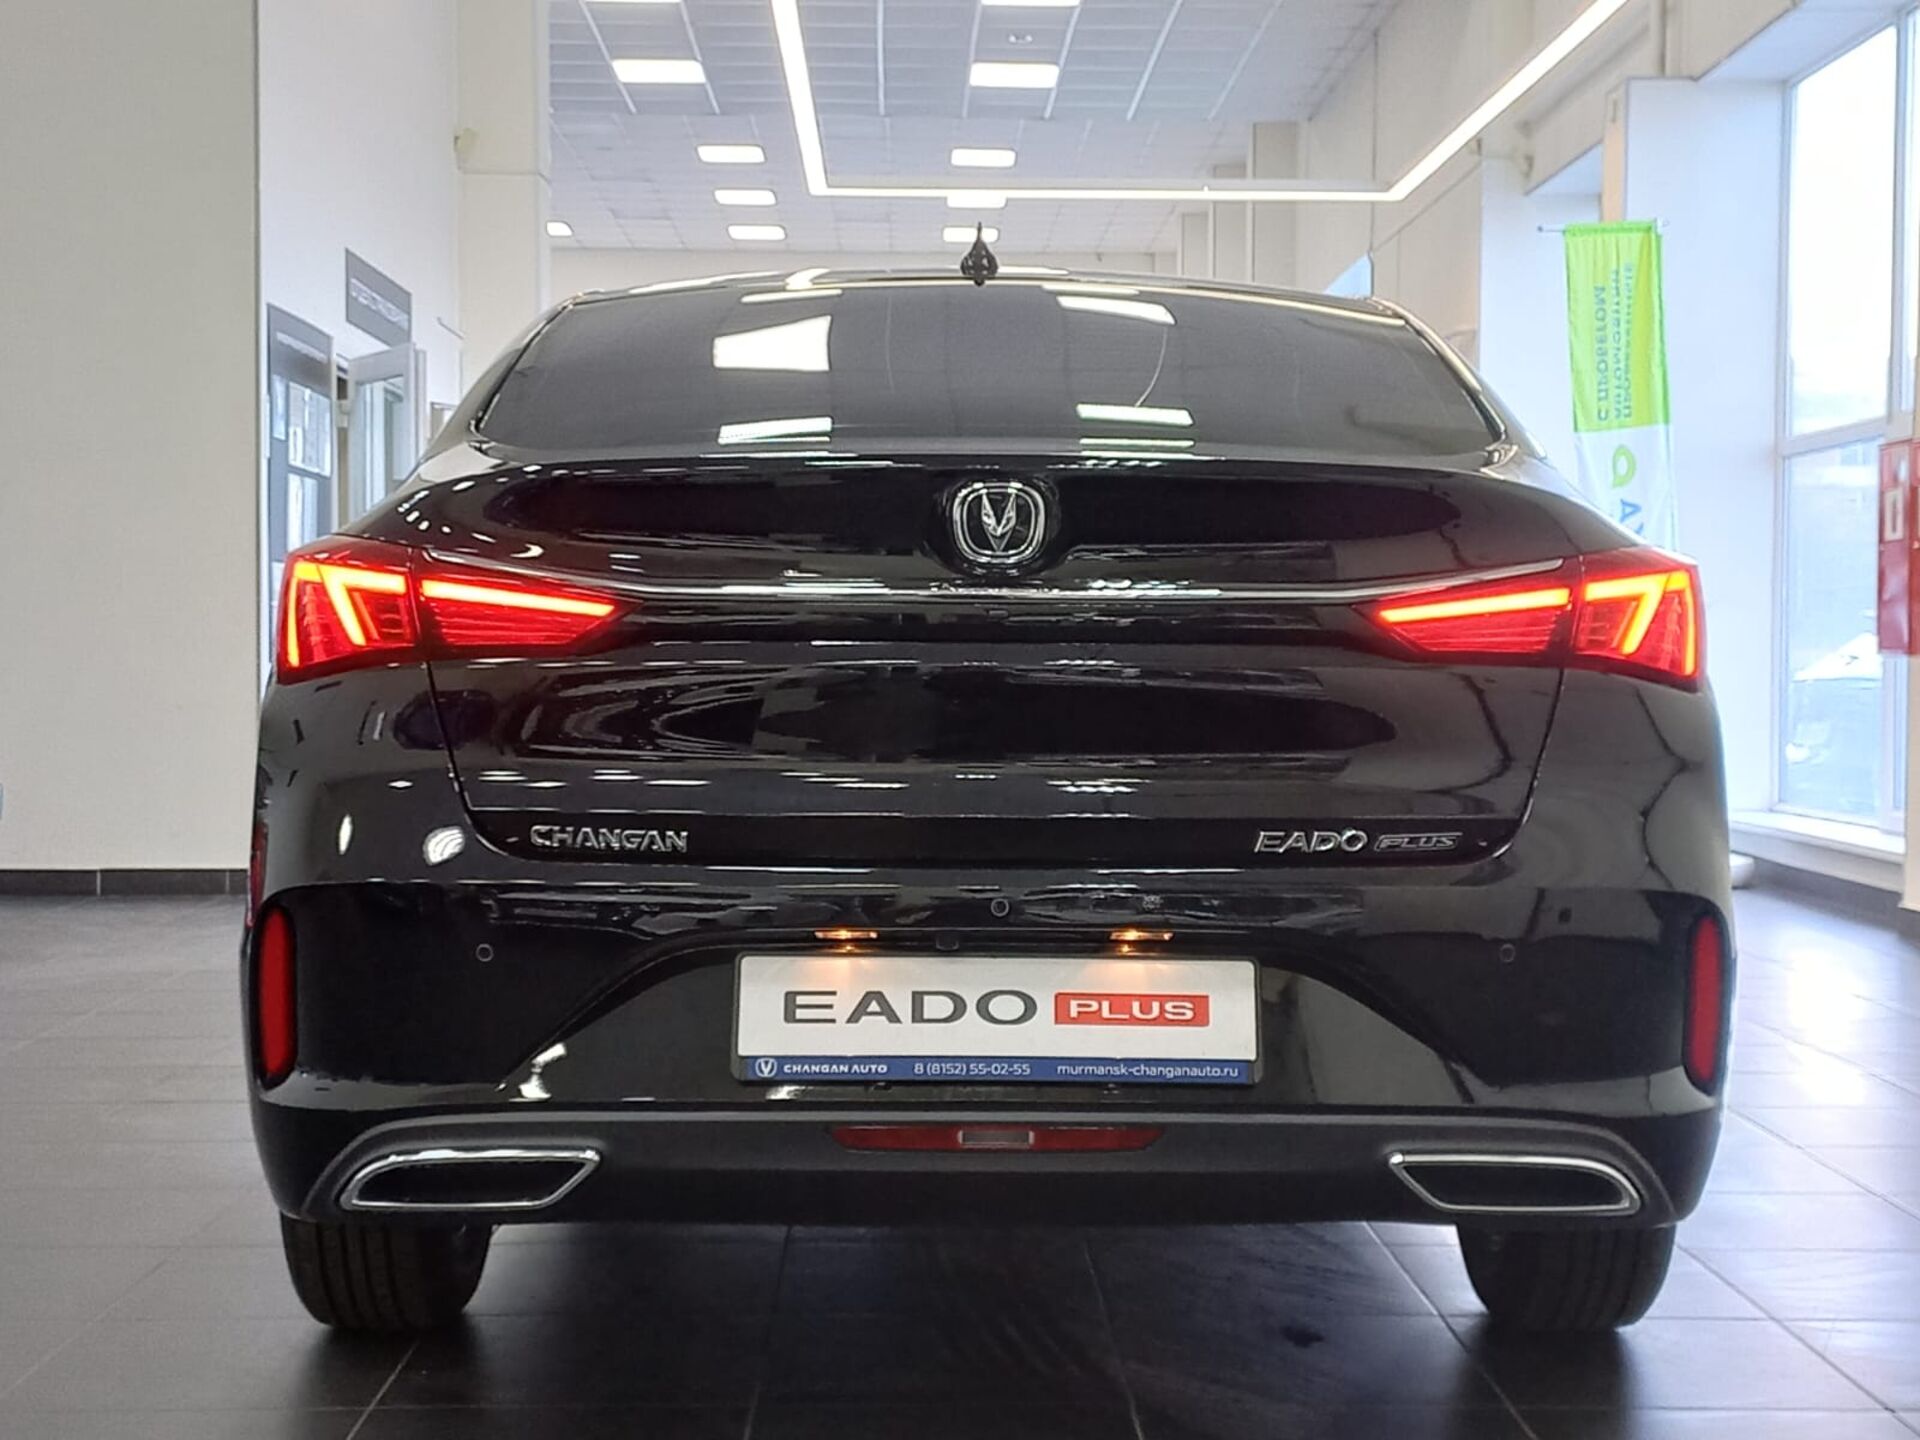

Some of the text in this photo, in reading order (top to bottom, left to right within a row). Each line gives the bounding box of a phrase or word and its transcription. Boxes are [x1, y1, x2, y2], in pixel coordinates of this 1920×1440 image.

[530, 825, 688, 852] CHANGAN
[1254, 830, 1459, 852] EADO PLUS
[784, 989, 1195, 1025] EADO PLUS
[783, 1064, 888, 1074] CHANGAN AUTO
[914, 1062, 1031, 1077] 8 (8152) 55-02-55
[1056, 1063, 1239, 1079] murmansk-changanauto.ru
